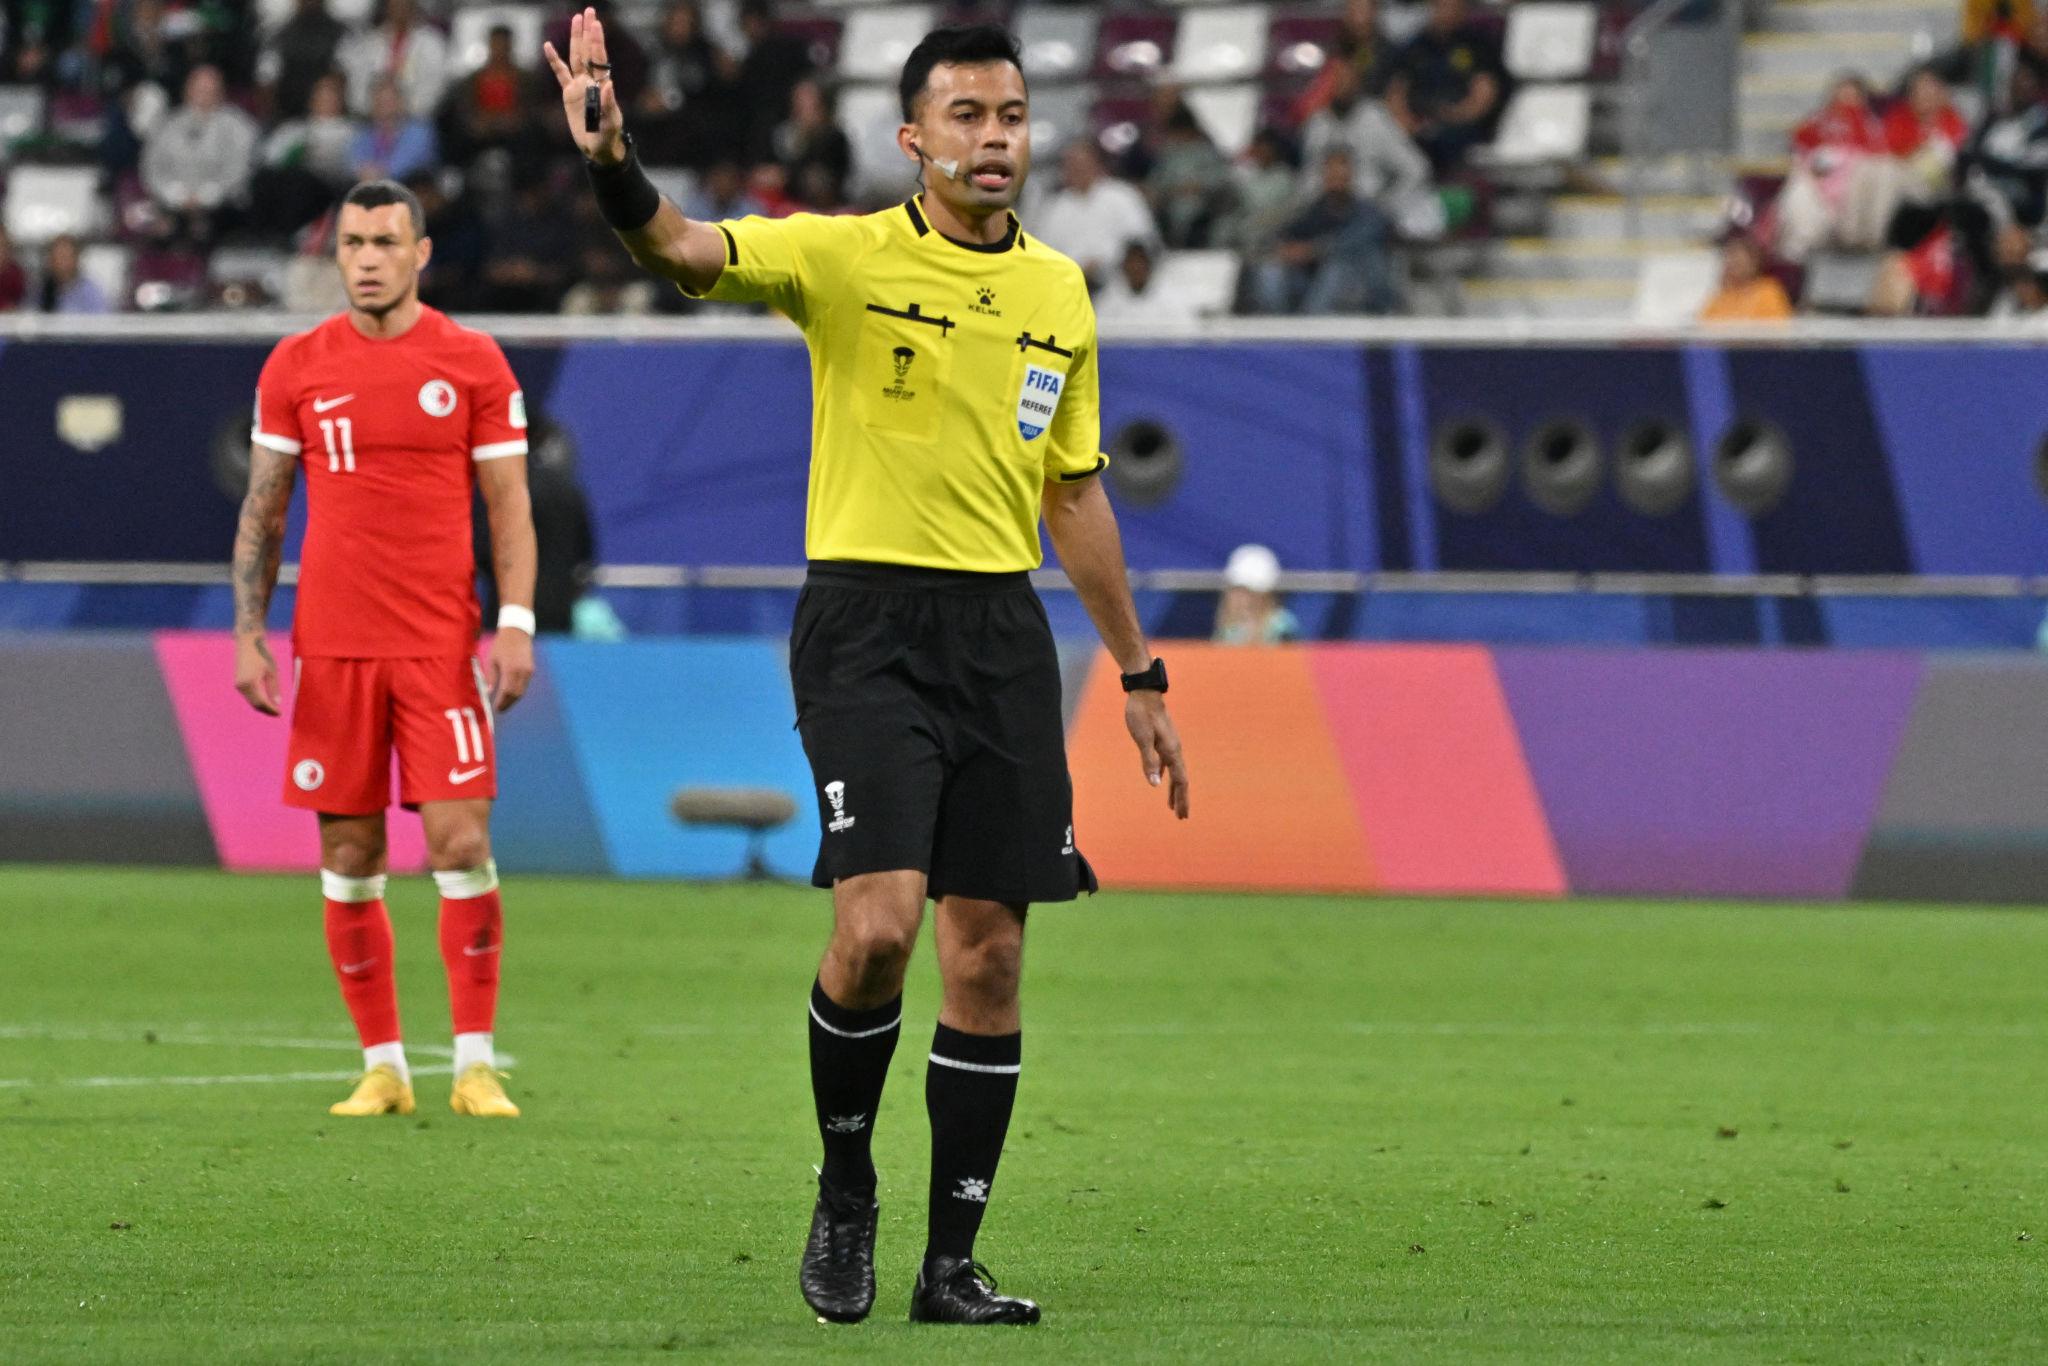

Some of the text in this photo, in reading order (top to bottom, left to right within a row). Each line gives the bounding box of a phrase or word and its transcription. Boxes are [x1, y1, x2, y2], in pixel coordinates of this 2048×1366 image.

[968, 304, 1001, 317] KELME
[1027, 370, 1059, 395] FIFA
[1021, 398, 1053, 416] REFEREE
[318, 417, 355, 472] 11
[444, 706, 484, 764] 11
